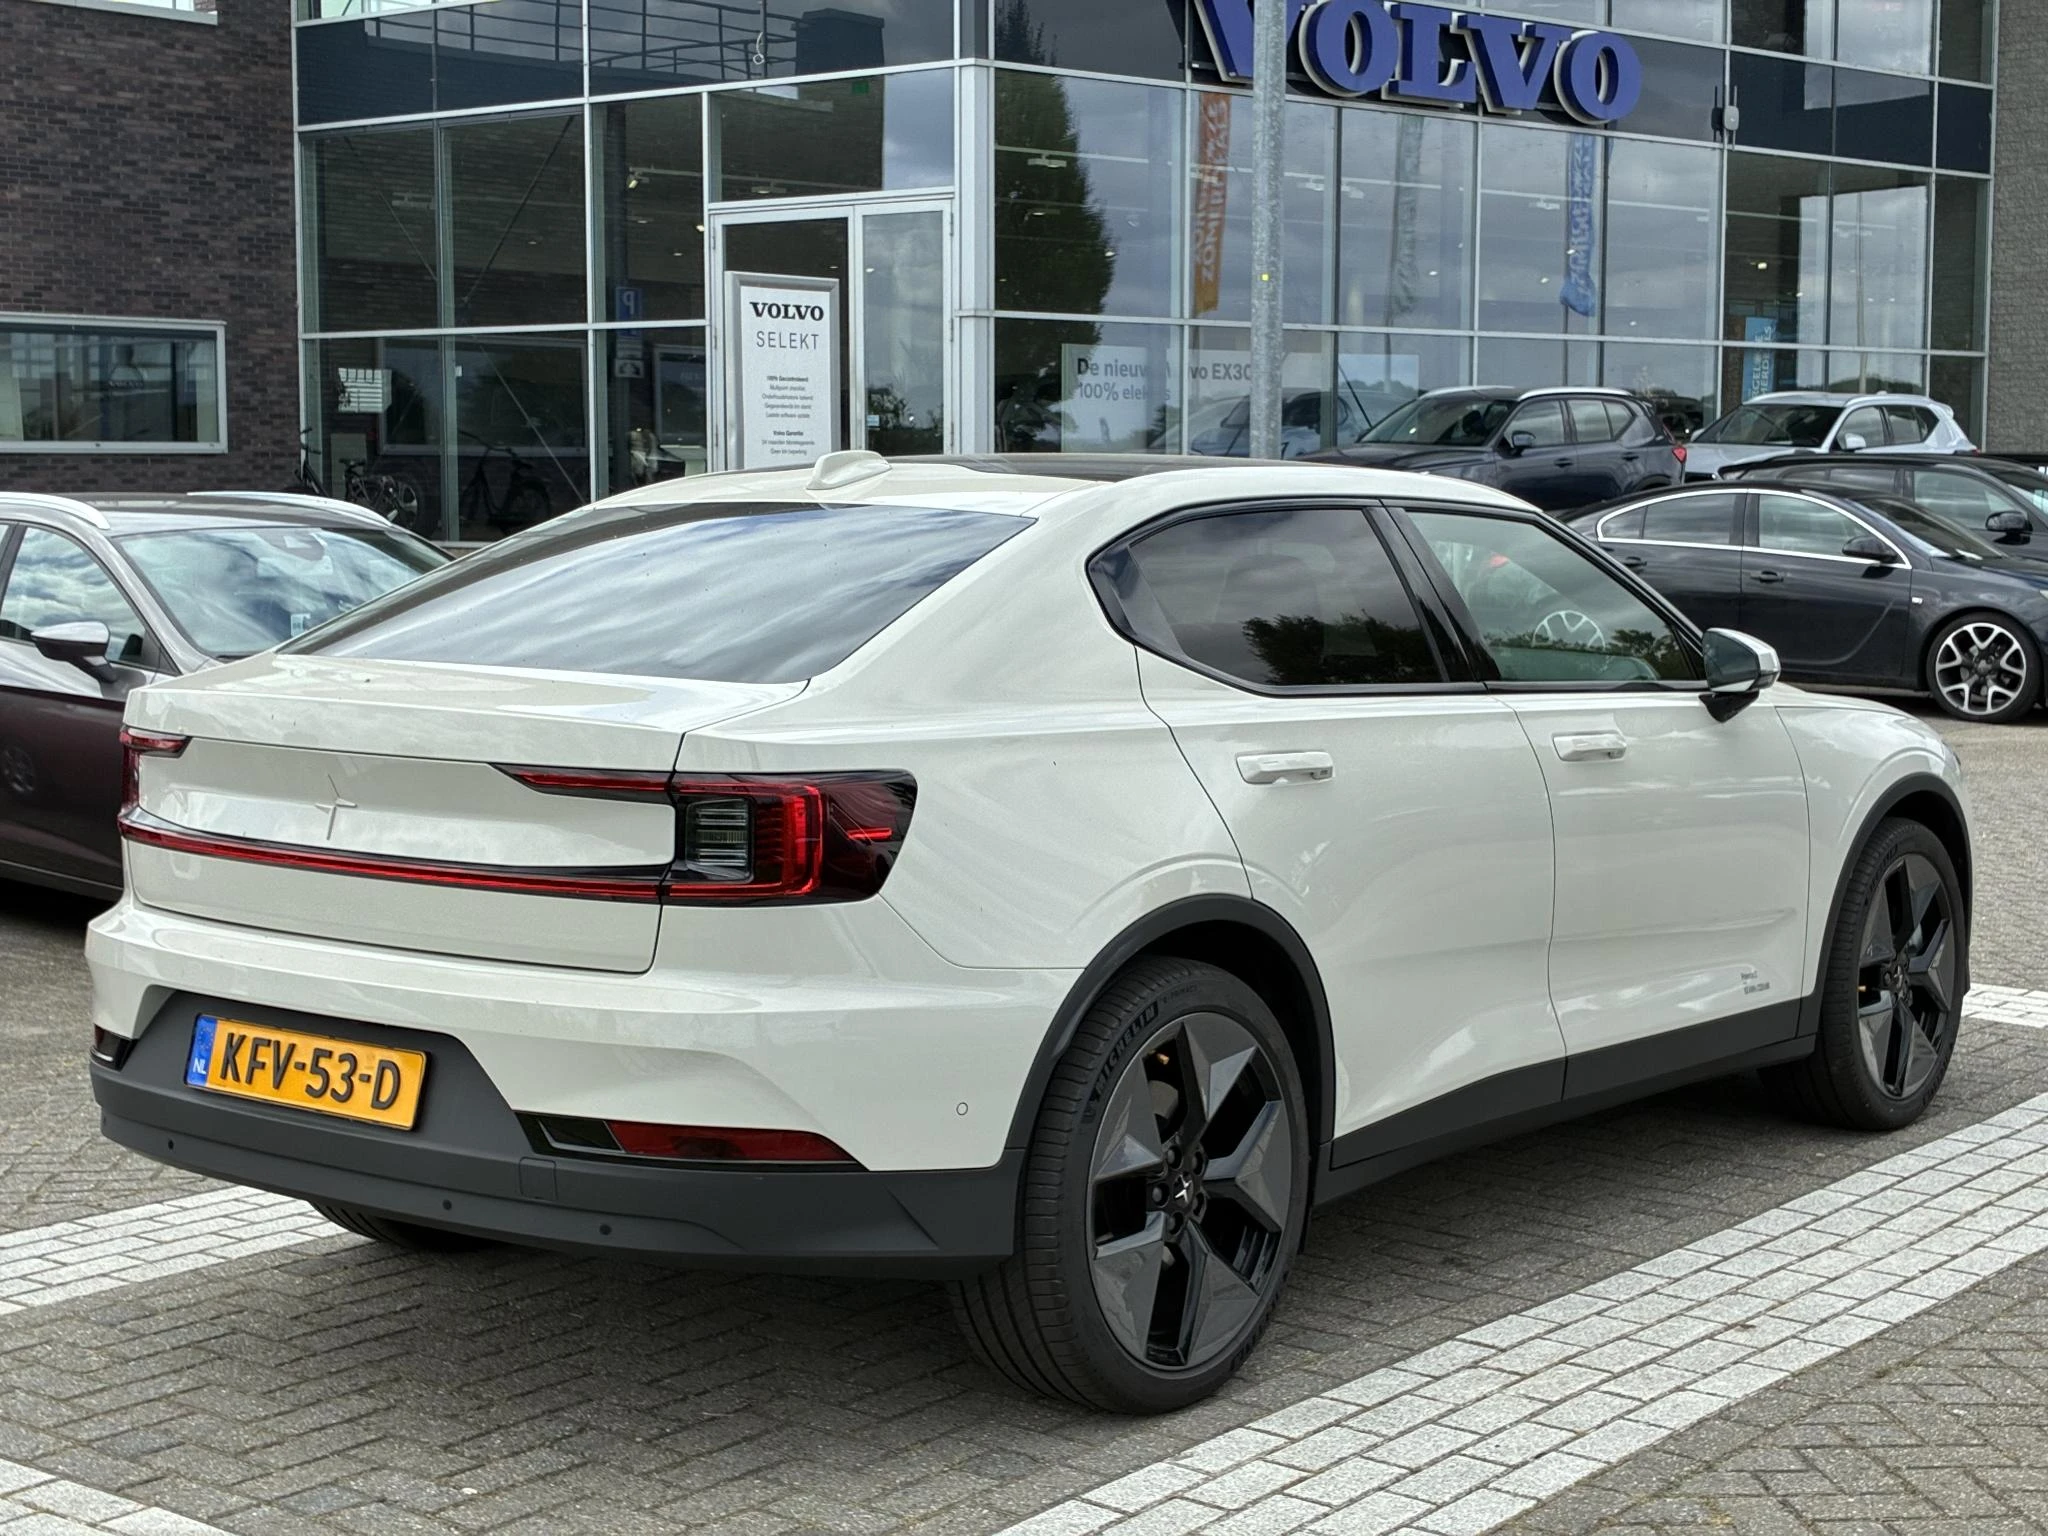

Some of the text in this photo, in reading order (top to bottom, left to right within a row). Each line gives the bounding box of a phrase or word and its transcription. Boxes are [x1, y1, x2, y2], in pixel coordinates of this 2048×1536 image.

[749, 301, 824, 321] VOLVO
[756, 330, 820, 350] SELEKT
[1077, 357, 1098, 376] De
[1212, 363, 1252, 381] EX30
[1079, 382, 1119, 401] 100%
[1093, 1002, 1157, 1097] MICHELIN
[193, 1031, 402, 1111] NL KFV-53-D
